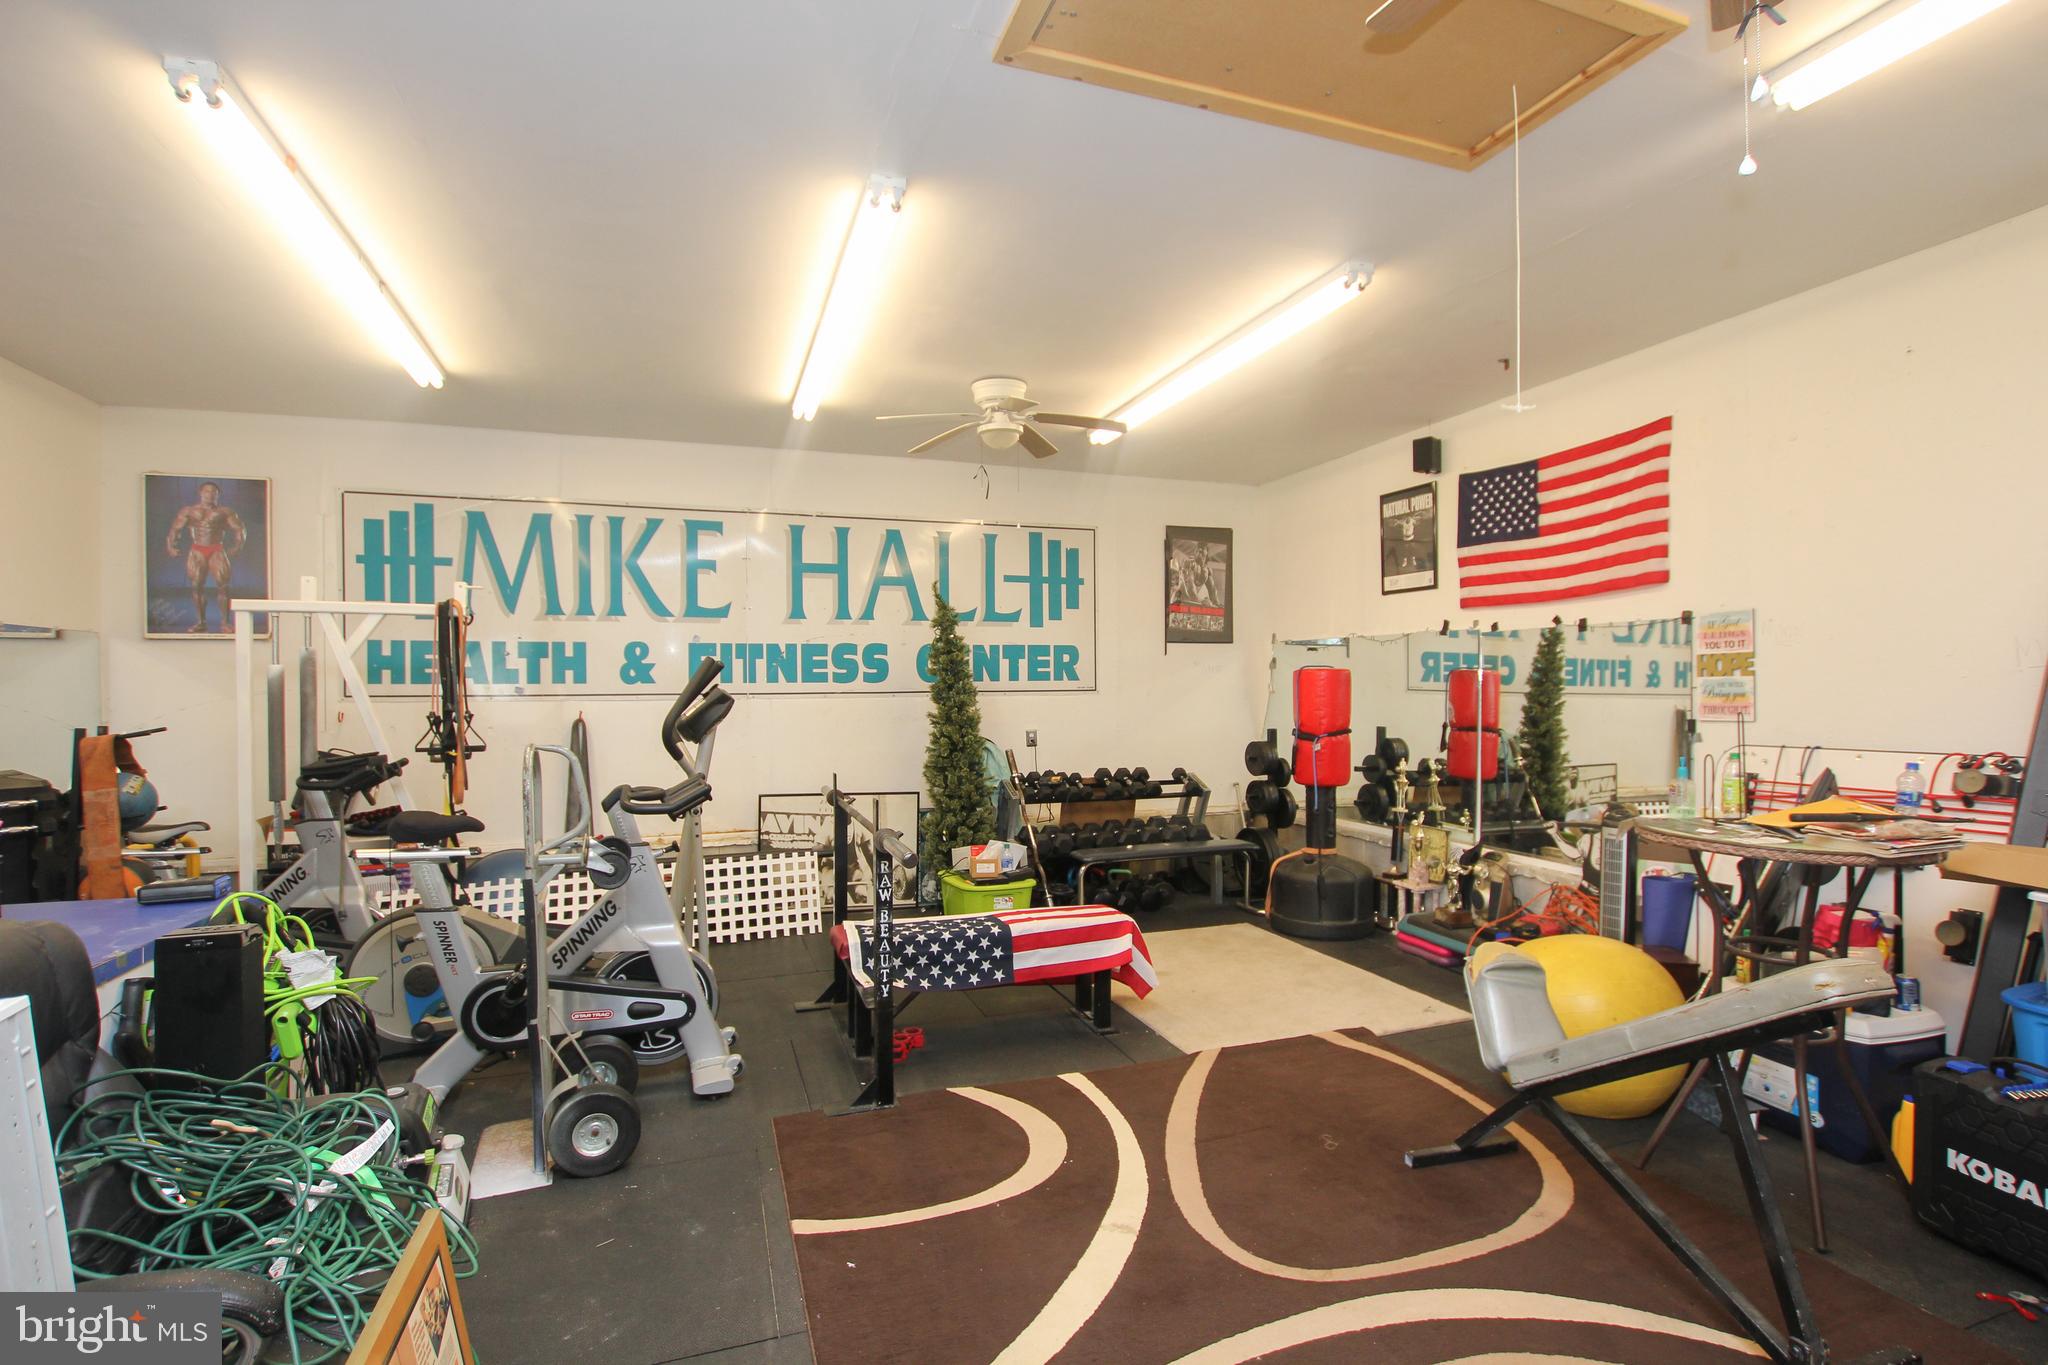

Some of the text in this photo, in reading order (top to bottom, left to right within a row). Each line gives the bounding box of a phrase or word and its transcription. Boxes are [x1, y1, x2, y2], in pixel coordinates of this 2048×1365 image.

[1383, 492, 1433, 518] NATURAL POWER
[462, 510, 1022, 622] MIKE HALL
[367, 639, 587, 684] HEALTH
[619, 640, 656, 685] &
[688, 642, 889, 684] FITNESS
[1697, 652, 1755, 677] HOPE
[1704, 639, 1746, 650] YOU TO IT
[433, 920, 458, 964] SPINNER
[551, 899, 617, 969] SPINNING
[878, 860, 892, 998] RAW BEAUTY
[1946, 1147, 2048, 1211] KOBA
